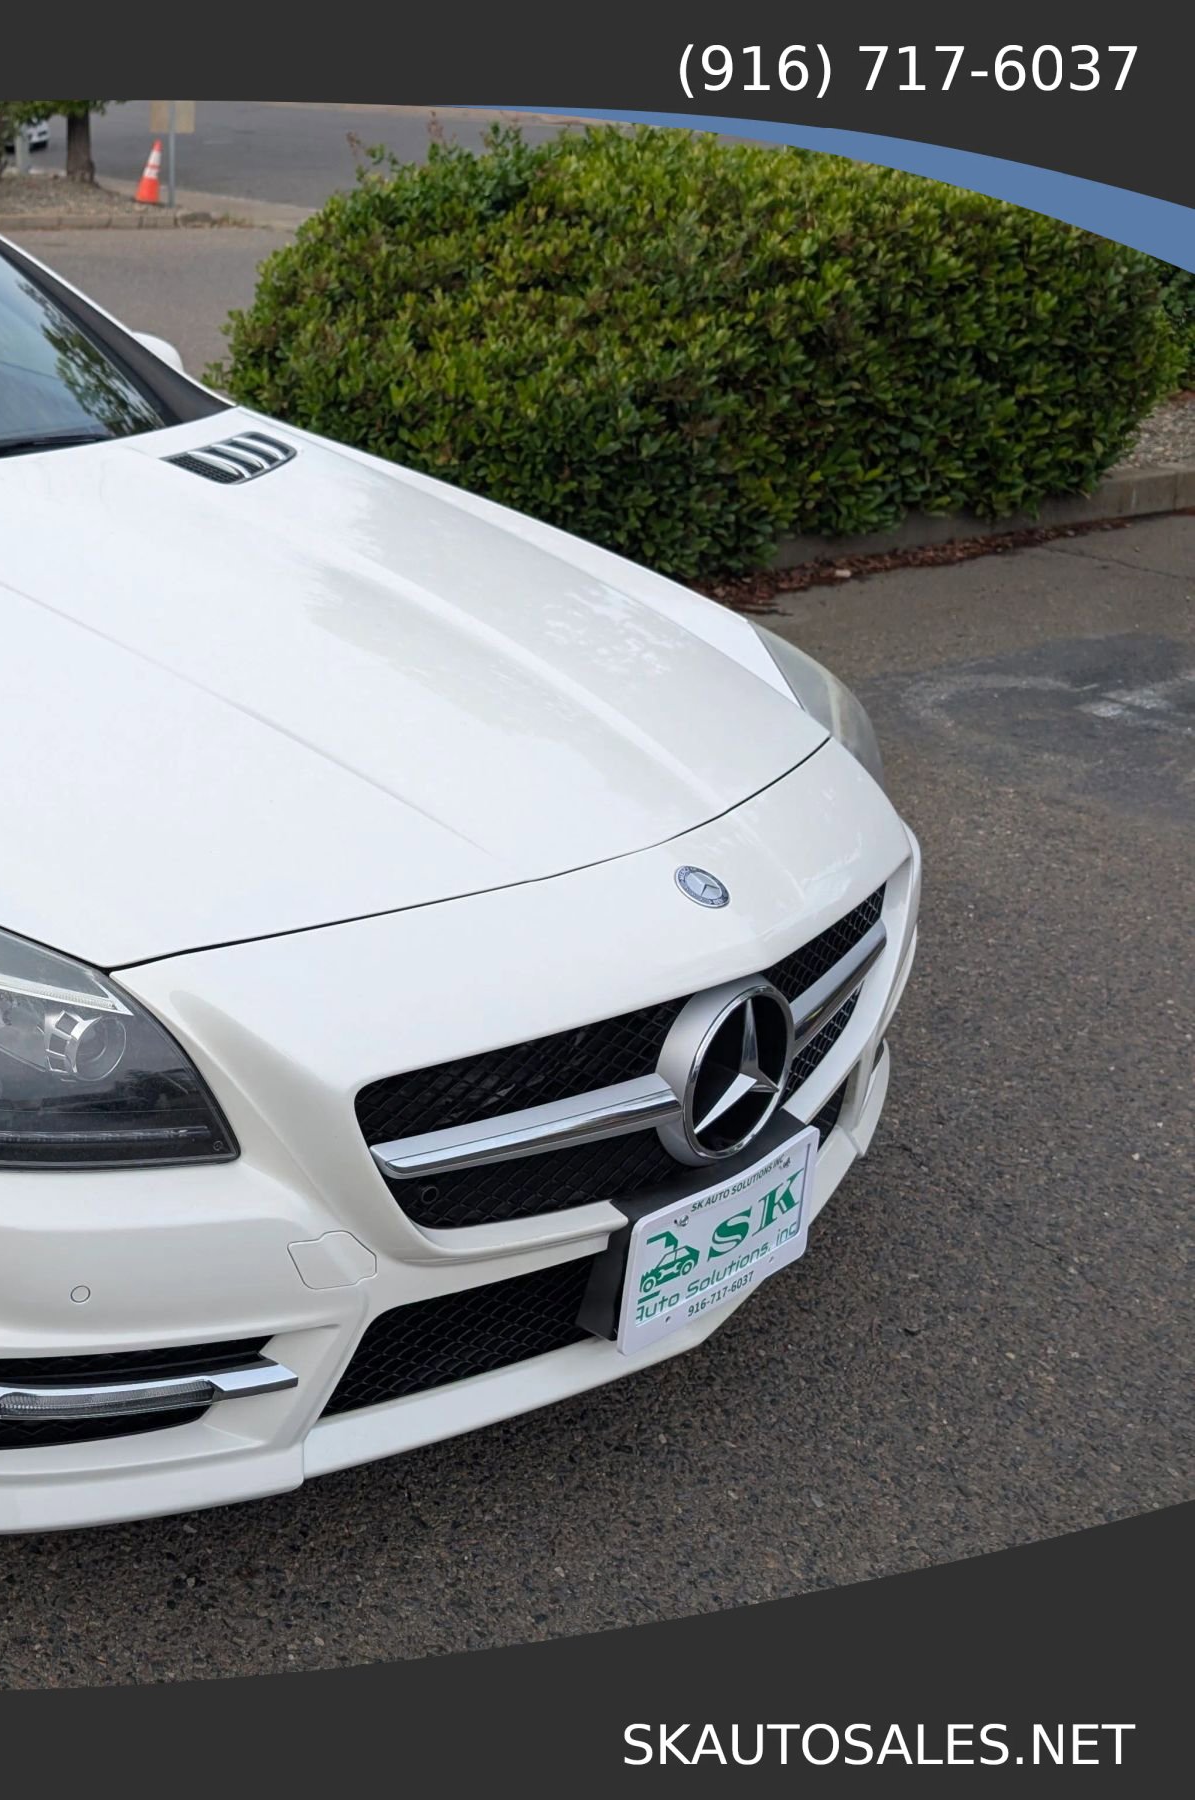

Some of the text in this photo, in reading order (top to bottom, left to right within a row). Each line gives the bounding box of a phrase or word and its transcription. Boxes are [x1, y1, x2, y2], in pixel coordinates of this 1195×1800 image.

[691, 1154, 785, 1212] SK AUTO SOLUTIONS INC
[707, 1168, 804, 1262] SK
[636, 1293, 680, 1322] Auto
[776, 1221, 798, 1247] inc
[688, 1270, 754, 1317] 916-717-6037
